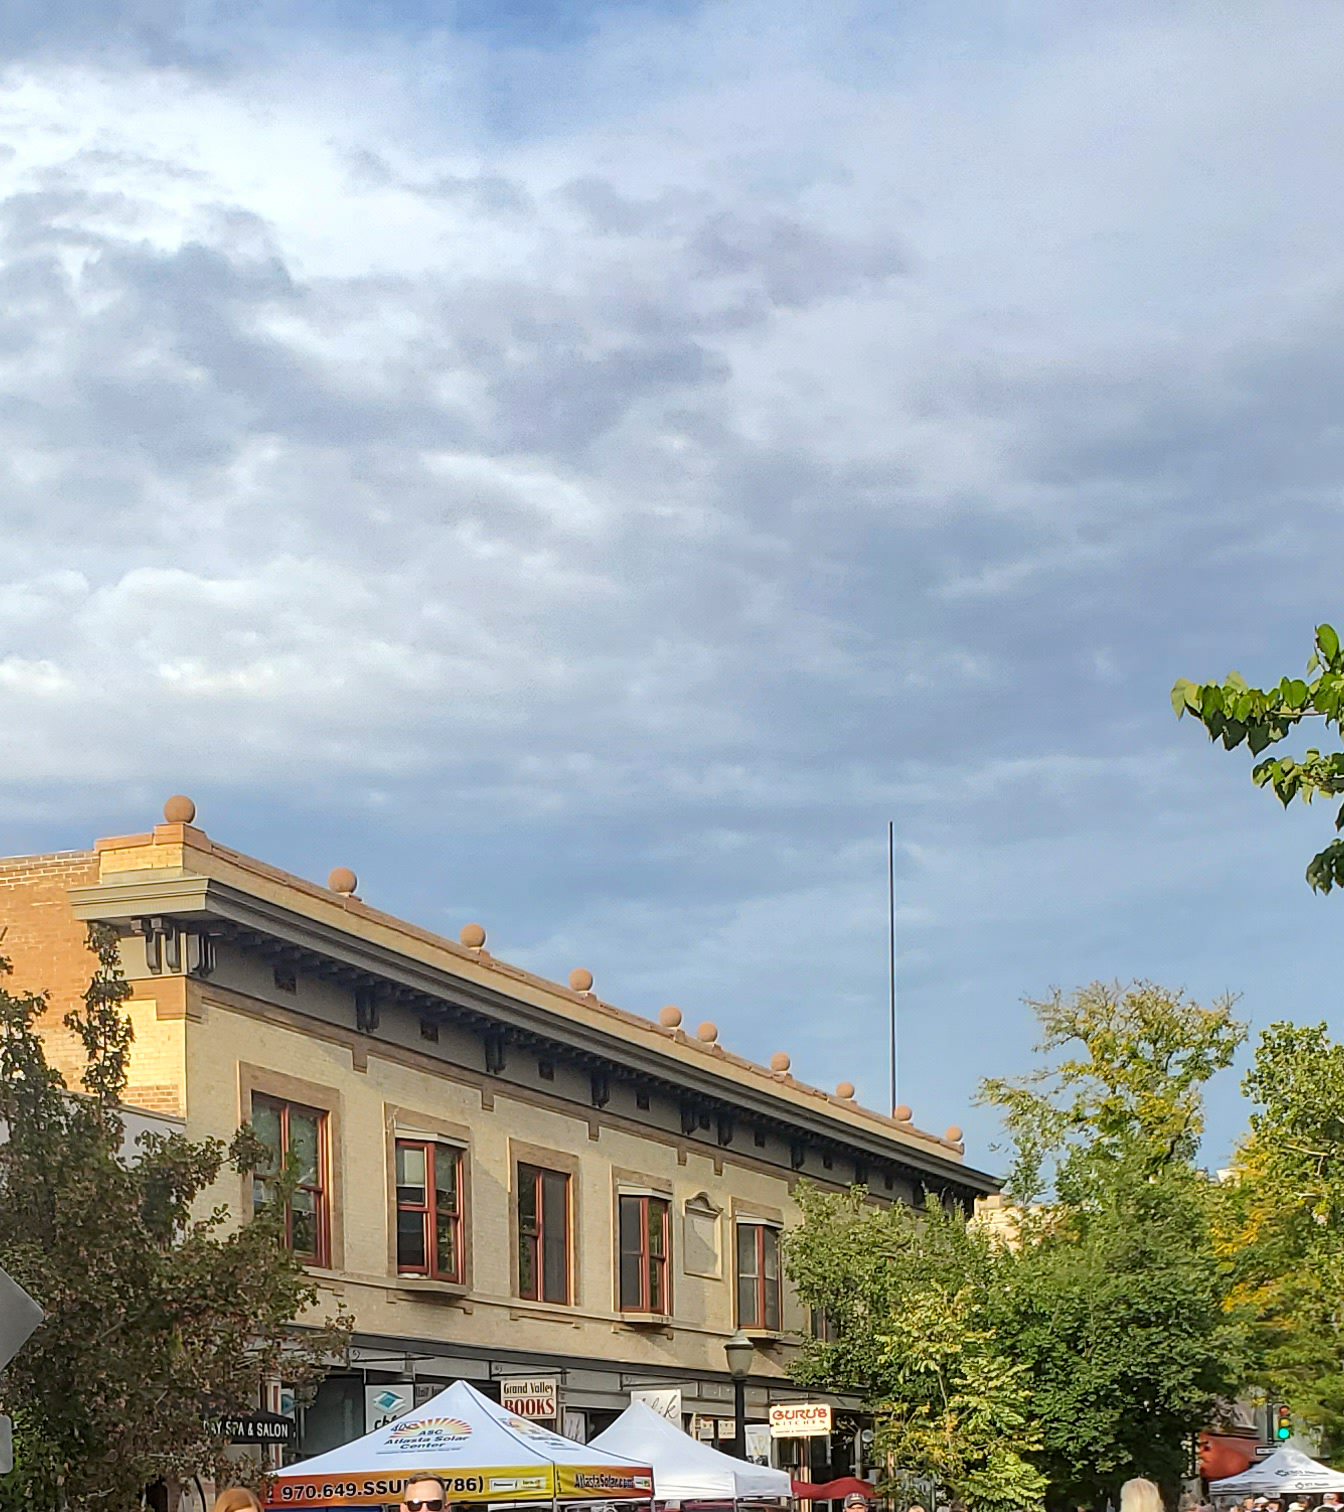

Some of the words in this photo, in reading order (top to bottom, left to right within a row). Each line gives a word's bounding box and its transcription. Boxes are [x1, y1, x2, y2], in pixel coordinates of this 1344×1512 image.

[503, 1382, 528, 1395] Grand
[529, 1382, 554, 1396] Valley
[504, 1398, 555, 1415] BOOKS
[772, 1407, 827, 1420] GURU'S
[225, 1421, 244, 1436] SPA
[247, 1422, 254, 1437] &
[256, 1423, 288, 1438] SALON
[399, 1442, 446, 1450] Center
